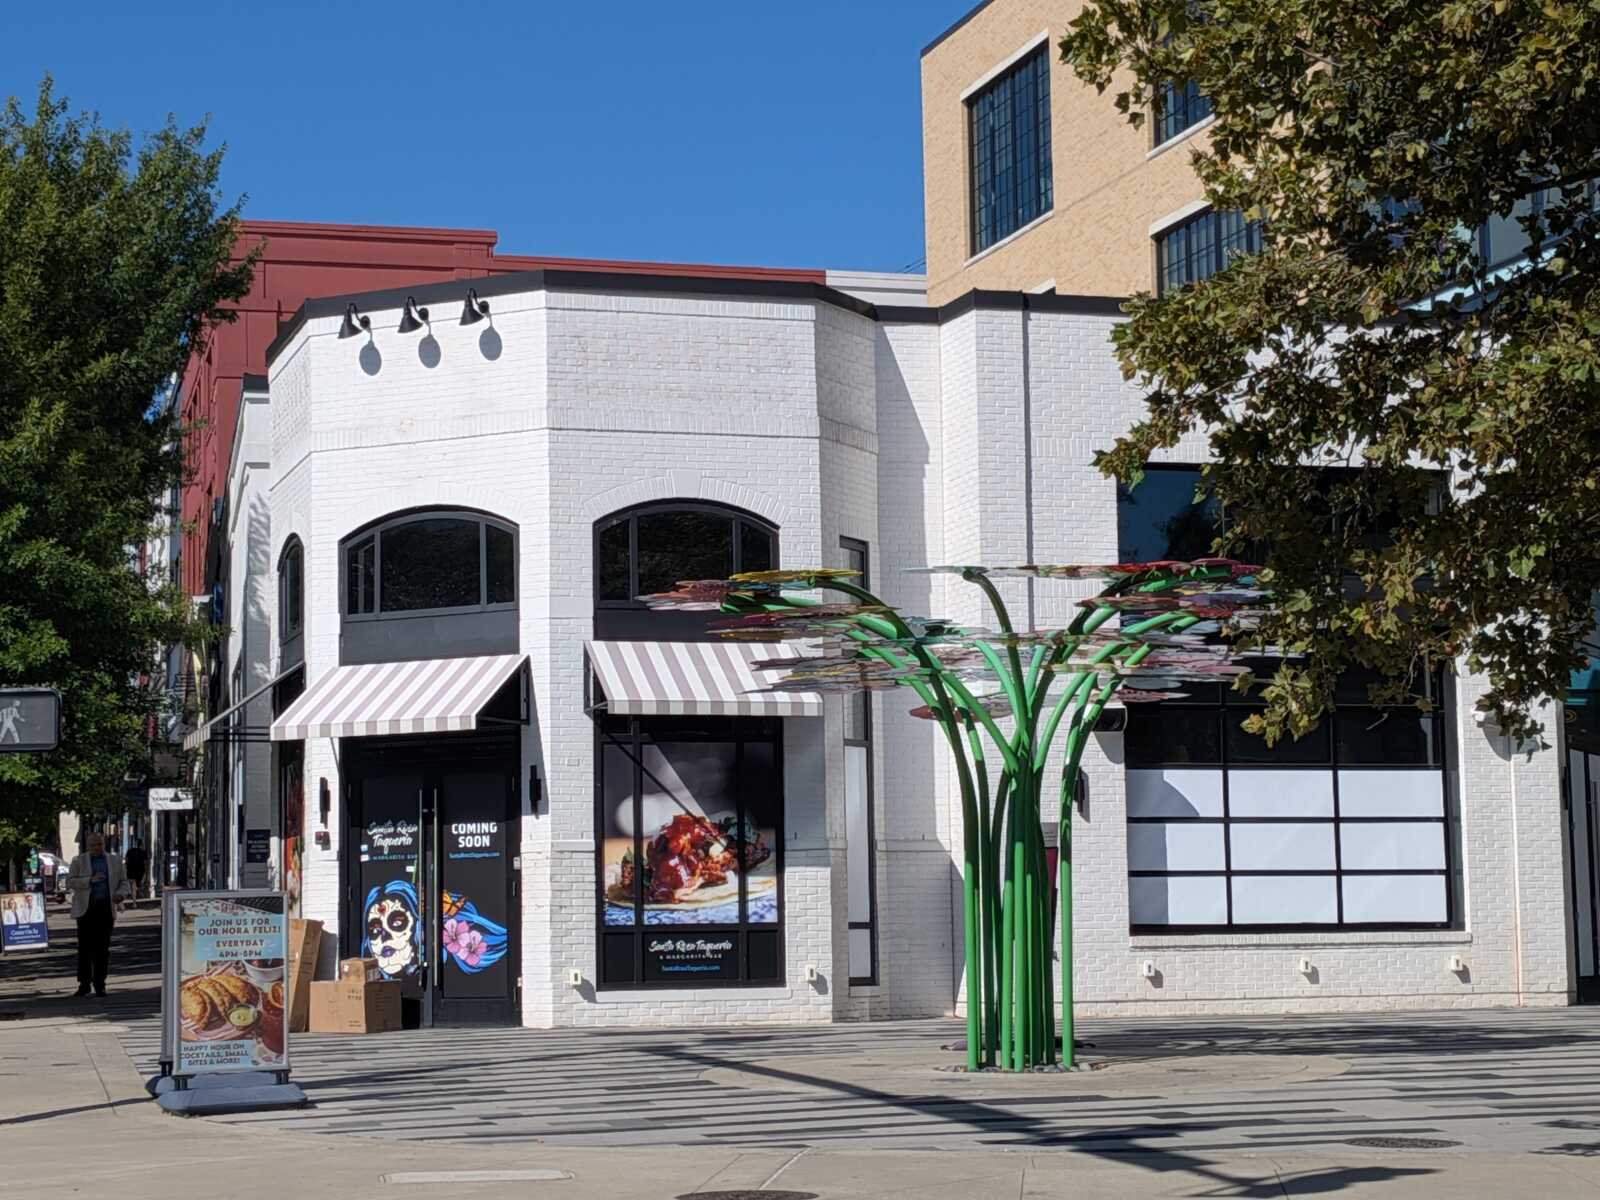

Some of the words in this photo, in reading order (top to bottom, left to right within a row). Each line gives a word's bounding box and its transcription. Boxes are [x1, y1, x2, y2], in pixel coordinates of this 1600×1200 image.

[367, 819, 395, 835] Santa
[397, 820, 418, 836] Rosa
[451, 822, 498, 834] COMING
[372, 834, 413, 855] Taqueria
[458, 835, 490, 848] SOON
[209, 918, 232, 927] JOIN
[236, 918, 248, 926] US
[251, 917, 270, 926] FOR
[198, 928, 219, 936] OUR
[222, 927, 250, 935] HORA
[253, 925, 281, 934] FELIZ!
[215, 939, 265, 948] EVERYDAY
[648, 939, 674, 952] Santa
[696, 939, 733, 957] Taqueria
[211, 1043, 231, 1051] HOUR
[232, 1042, 245, 1050] ON
